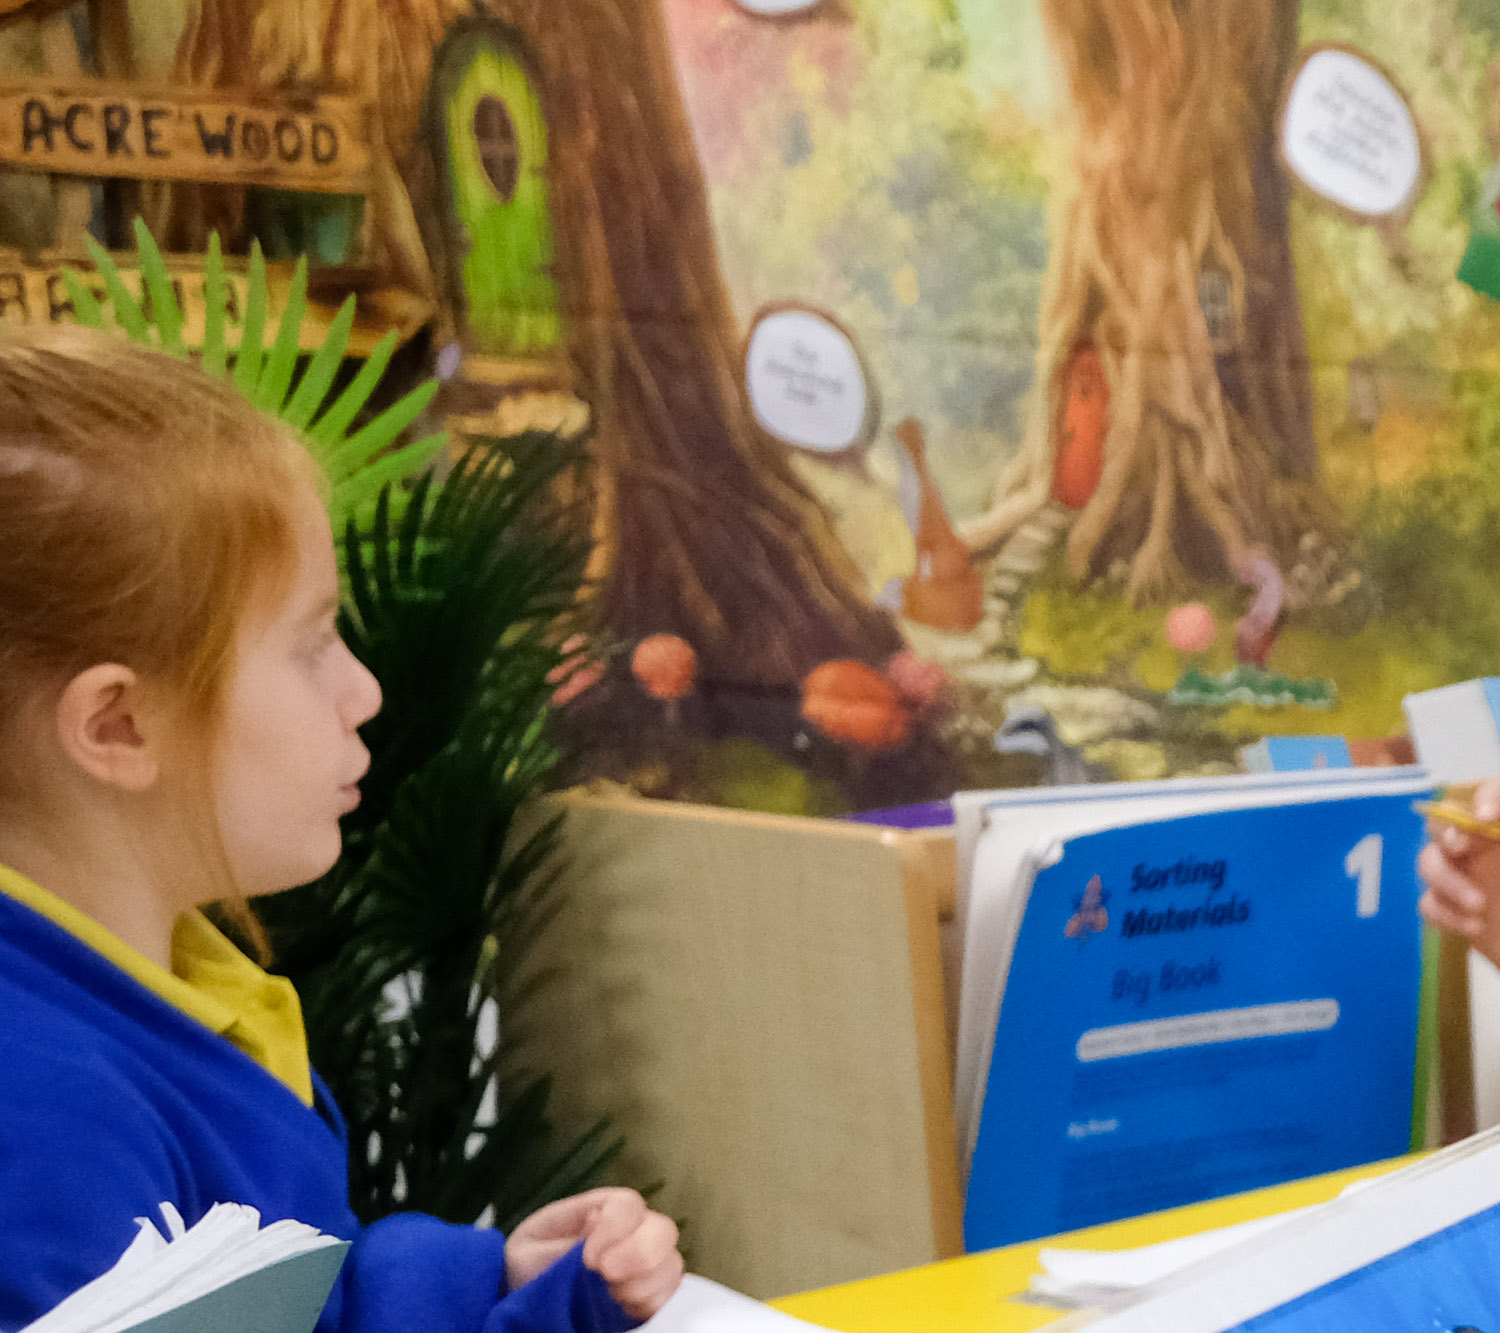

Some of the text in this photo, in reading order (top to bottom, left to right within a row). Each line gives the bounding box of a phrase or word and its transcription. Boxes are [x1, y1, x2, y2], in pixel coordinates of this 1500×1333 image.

[22, 98, 340, 166] ACRE WOOD
[1130, 857, 1228, 893] Sorting
[1344, 832, 1384, 918] 1
[1120, 893, 1249, 938] Materials
